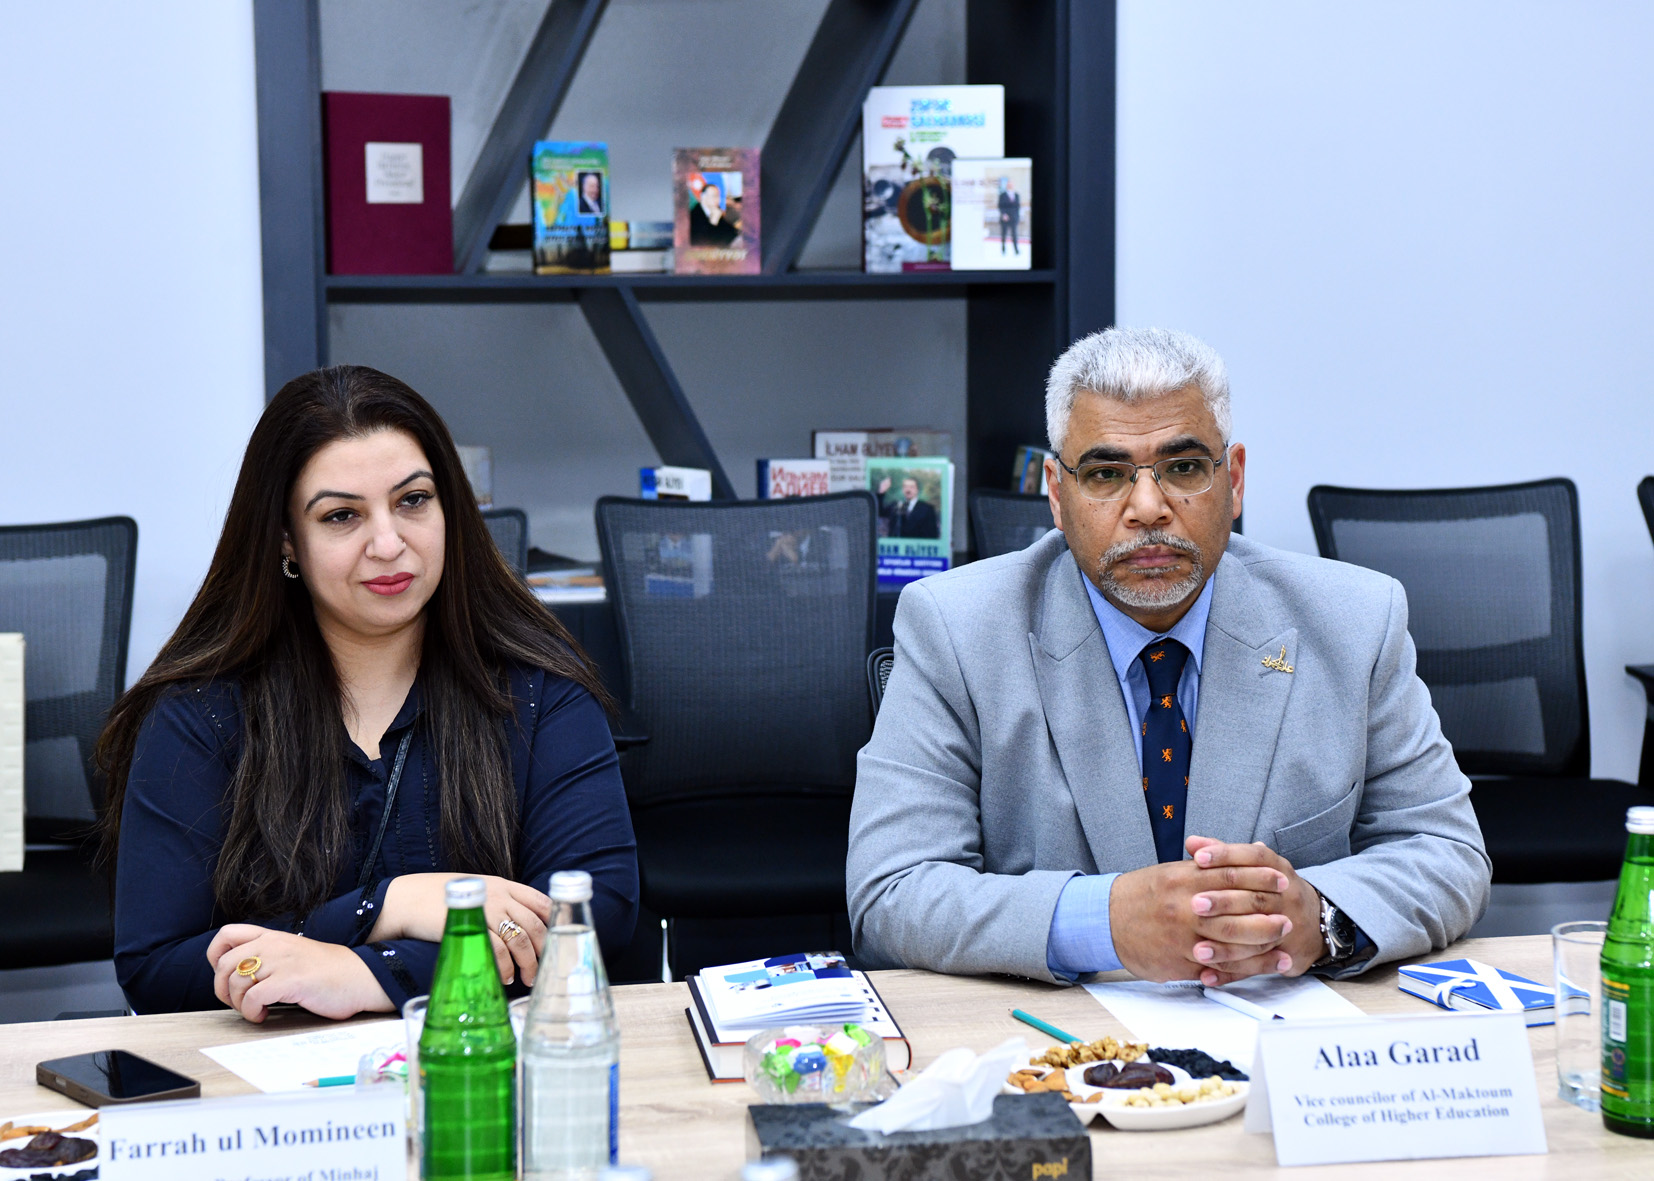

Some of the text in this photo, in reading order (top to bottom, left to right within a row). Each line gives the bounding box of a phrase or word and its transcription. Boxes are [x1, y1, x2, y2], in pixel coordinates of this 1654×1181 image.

[772, 482, 829, 498] АЛИЕВ
[1313, 1037, 1481, 1070] Alaa Garad
[1295, 1086, 1513, 1108] Vice councilor of Al-Maktoum
[1303, 1104, 1510, 1128] College of Higher Education
[110, 1119, 396, 1162] Farrah ul Momineen
[1032, 1157, 1069, 1181] papi
